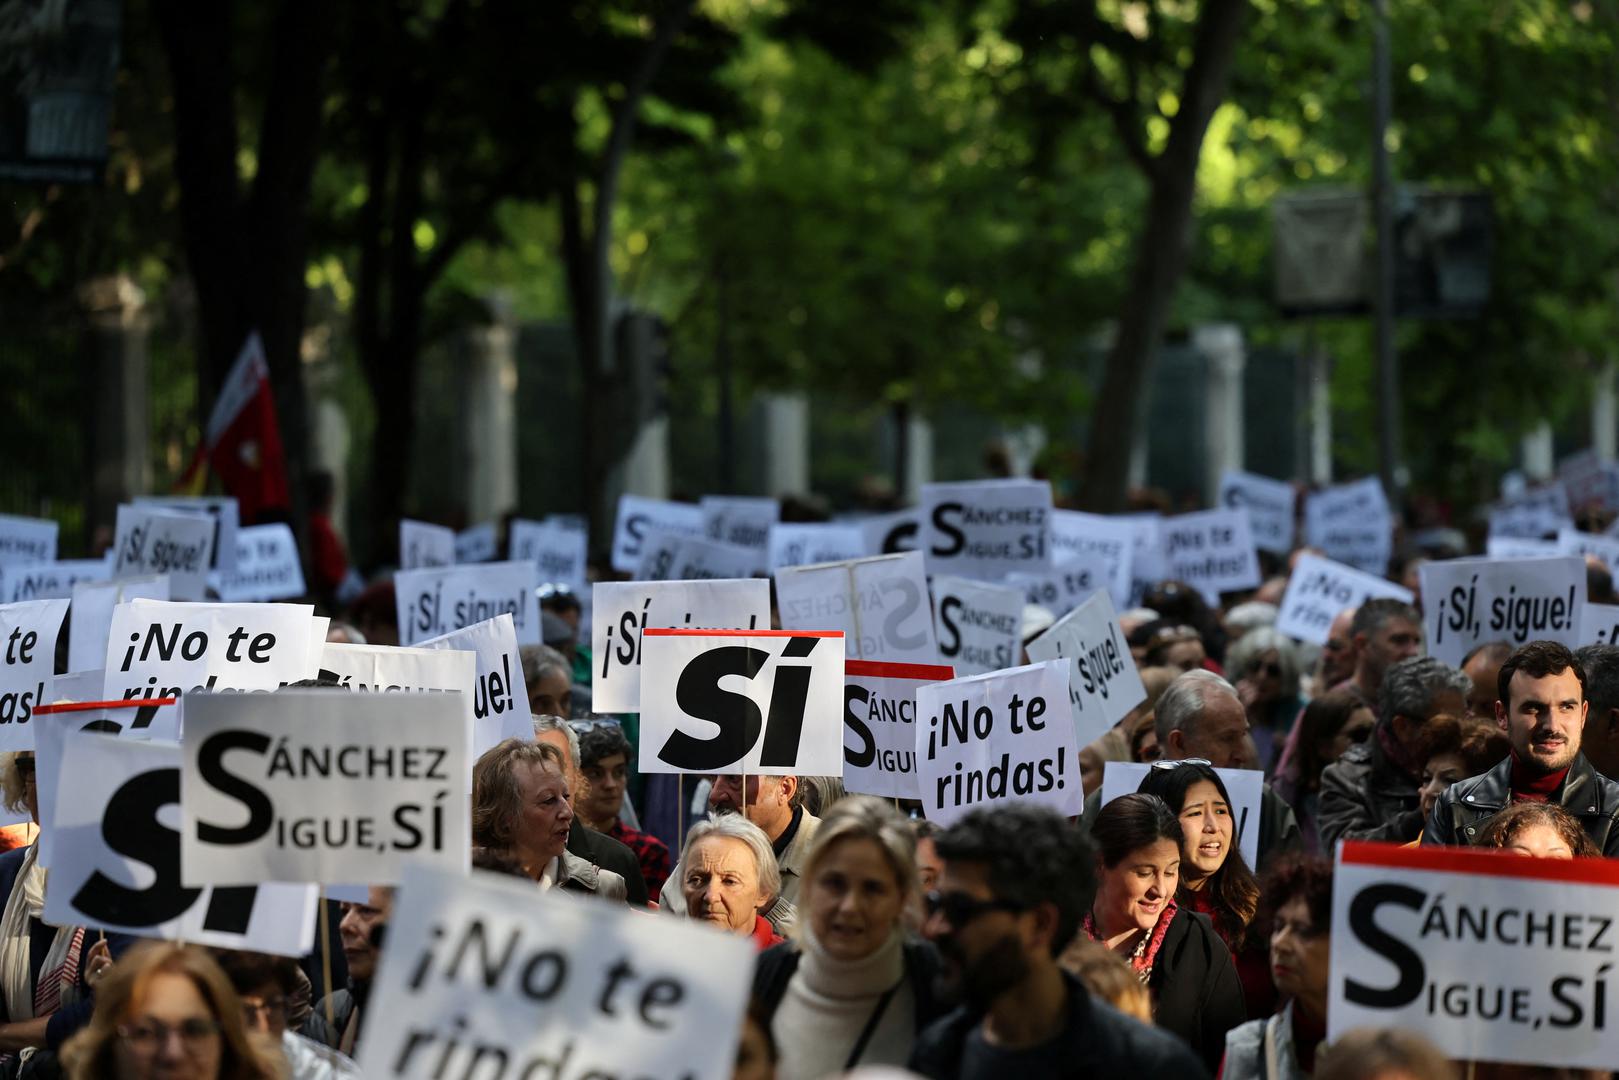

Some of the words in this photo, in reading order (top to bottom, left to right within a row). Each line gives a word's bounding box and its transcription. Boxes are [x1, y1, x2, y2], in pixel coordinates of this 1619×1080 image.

[5, 626, 38, 665] te
[120, 622, 210, 672] ¡No
[225, 626, 277, 664] te
[1490, 585, 1577, 643] sigue!
[1078, 621, 1125, 700] sigue!
[927, 699, 993, 760] ¡No
[1008, 693, 1047, 735] te
[196, 728, 449, 848] SÁNCHEZ
[936, 746, 1066, 809] rindas!
[406, 916, 571, 1003] ¡No
[595, 952, 690, 1033] te
[1343, 881, 1614, 1012] SÁNCHEZ
